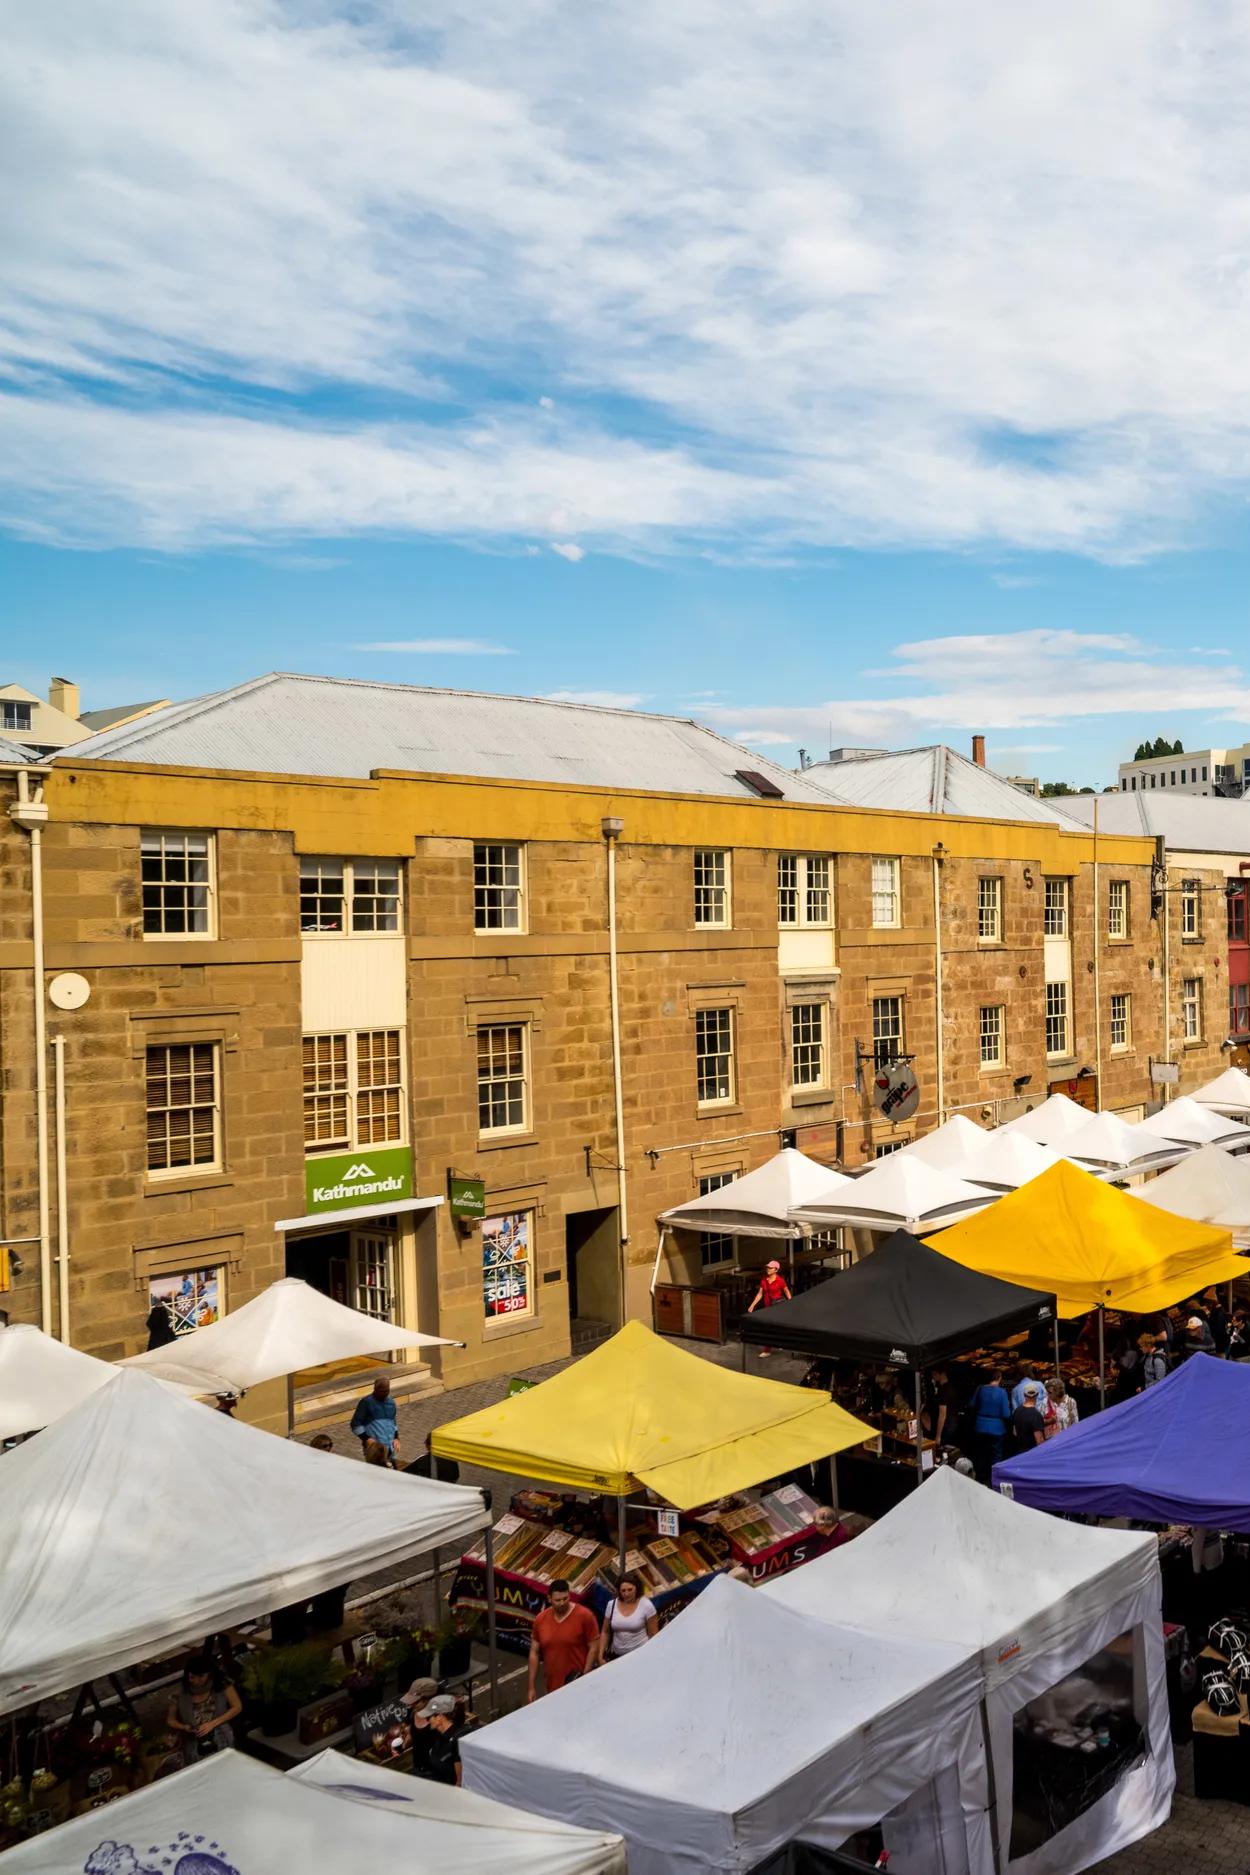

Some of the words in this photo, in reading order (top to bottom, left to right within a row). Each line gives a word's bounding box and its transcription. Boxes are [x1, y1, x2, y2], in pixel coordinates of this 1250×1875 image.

[313, 1176, 404, 1203] Kathmandu
[452, 1197, 484, 1208] Kathmandu
[488, 1280, 520, 1302] sale
[361, 1702, 395, 1730] Native
